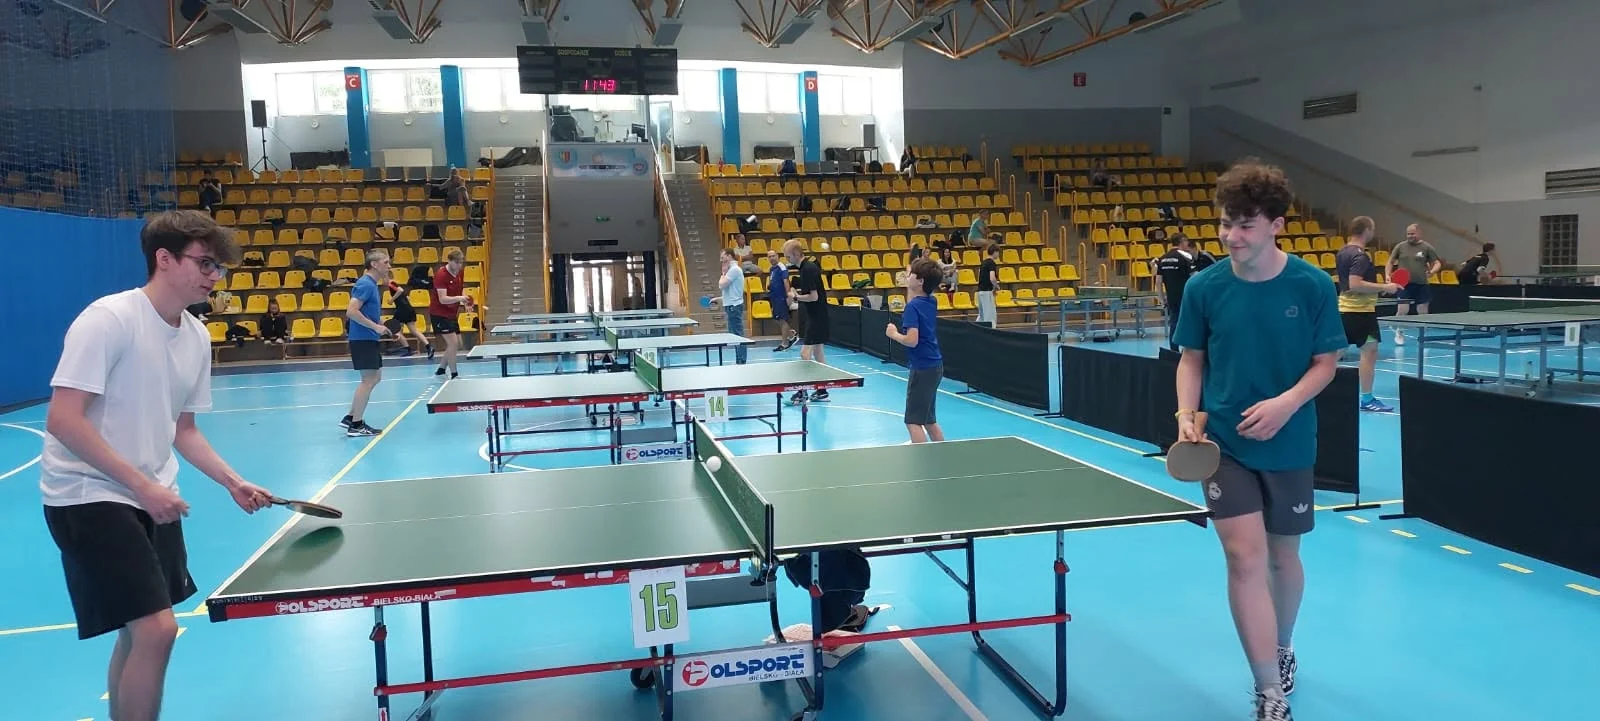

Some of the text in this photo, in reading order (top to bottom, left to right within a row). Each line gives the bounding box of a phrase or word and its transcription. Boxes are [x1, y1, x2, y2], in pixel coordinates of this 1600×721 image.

[349, 78, 357, 88] C
[808, 80, 815, 90] D
[708, 395, 725, 417] 14
[626, 447, 684, 461] POLSPORT
[274, 595, 364, 615] POLSPORT
[639, 581, 679, 632] 15
[681, 653, 805, 687] POLSPORT
